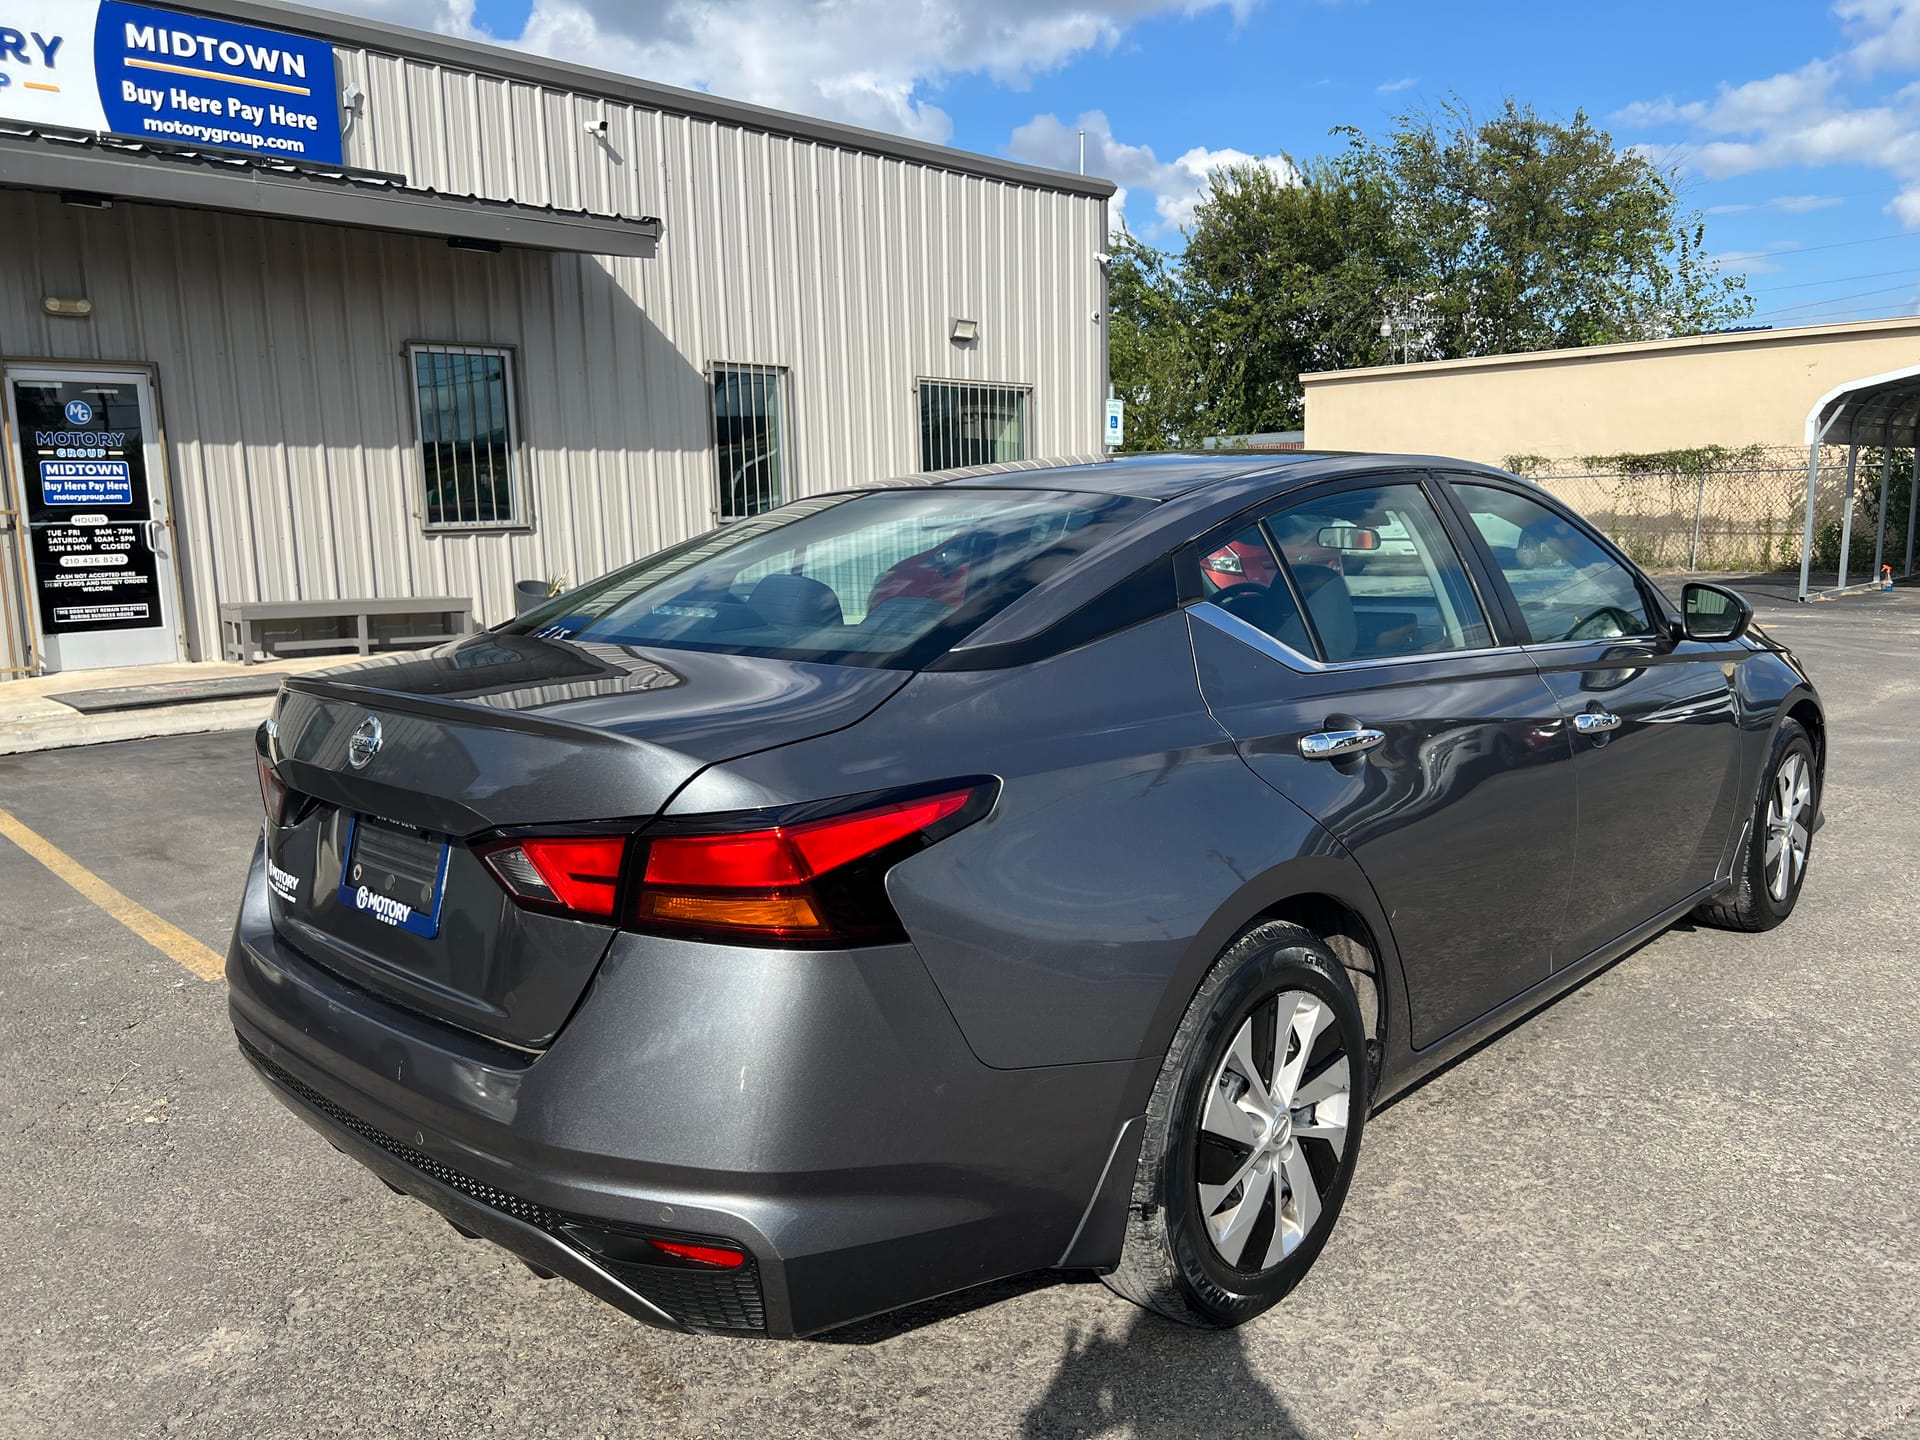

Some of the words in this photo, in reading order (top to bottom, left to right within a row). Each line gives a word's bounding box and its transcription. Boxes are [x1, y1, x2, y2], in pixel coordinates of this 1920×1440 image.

[124, 22, 306, 79] MIDTOWN
[121, 79, 165, 112] Buy
[170, 87, 222, 116] Here
[228, 96, 267, 128] Pay
[270, 102, 319, 131] Here
[143, 116, 305, 153] motorygroup.com
[35, 431, 125, 447] MOTORY
[56, 448, 106, 458] GROUP
[46, 464, 124, 475] MIDTOWN
[44, 481, 62, 493] Buy
[64, 482, 86, 491] Here
[89, 481, 105, 493] Pay
[106, 482, 129, 490] Here
[53, 493, 123, 502] motorygroup.com
[74, 516, 104, 524] HOURS
[47, 529, 62, 537] TUE
[48, 536, 88, 544] SATURDAY
[48, 544, 65, 552] SUN
[73, 543, 92, 551] MON
[88, 571, 120, 579] ACCEPTED
[82, 585, 113, 593] WELCOME
[272, 865, 299, 890] MOTORY
[367, 892, 411, 922] MOTORY
